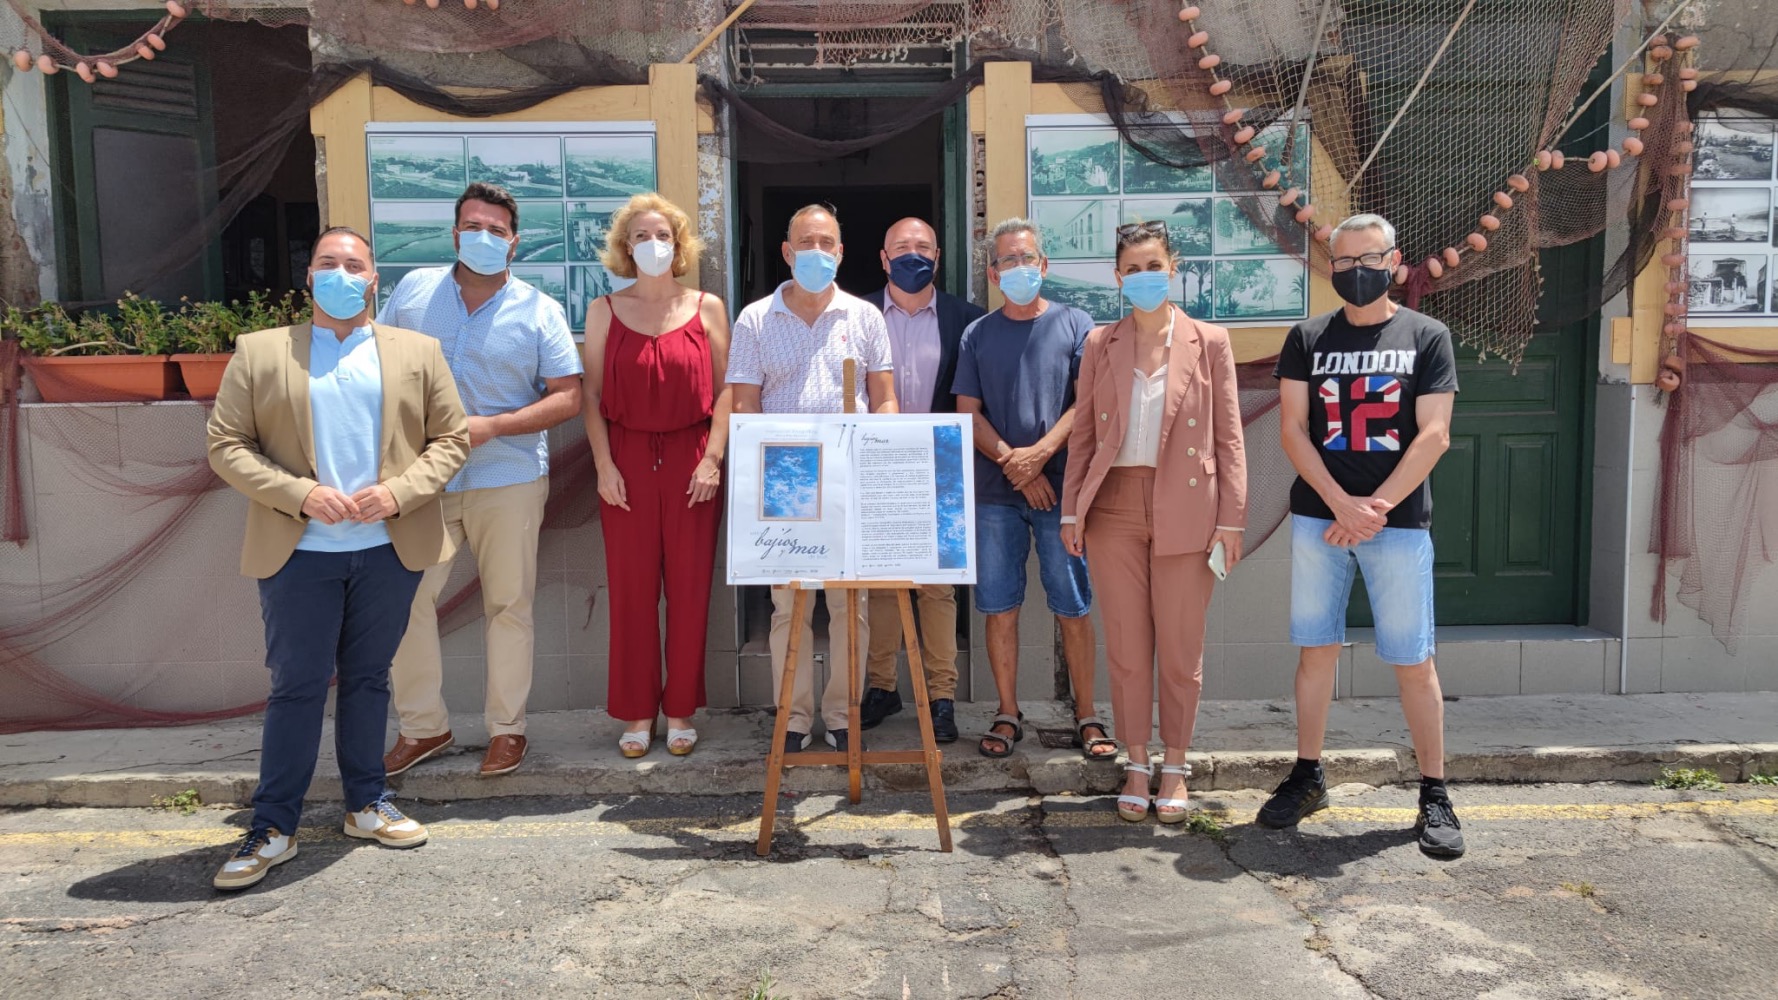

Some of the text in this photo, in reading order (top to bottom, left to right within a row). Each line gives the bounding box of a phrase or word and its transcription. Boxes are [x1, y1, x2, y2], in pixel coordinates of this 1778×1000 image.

[1311, 350, 1417, 375] LONDON
[1318, 376, 1401, 451] 12
[788, 544, 831, 555] mar
